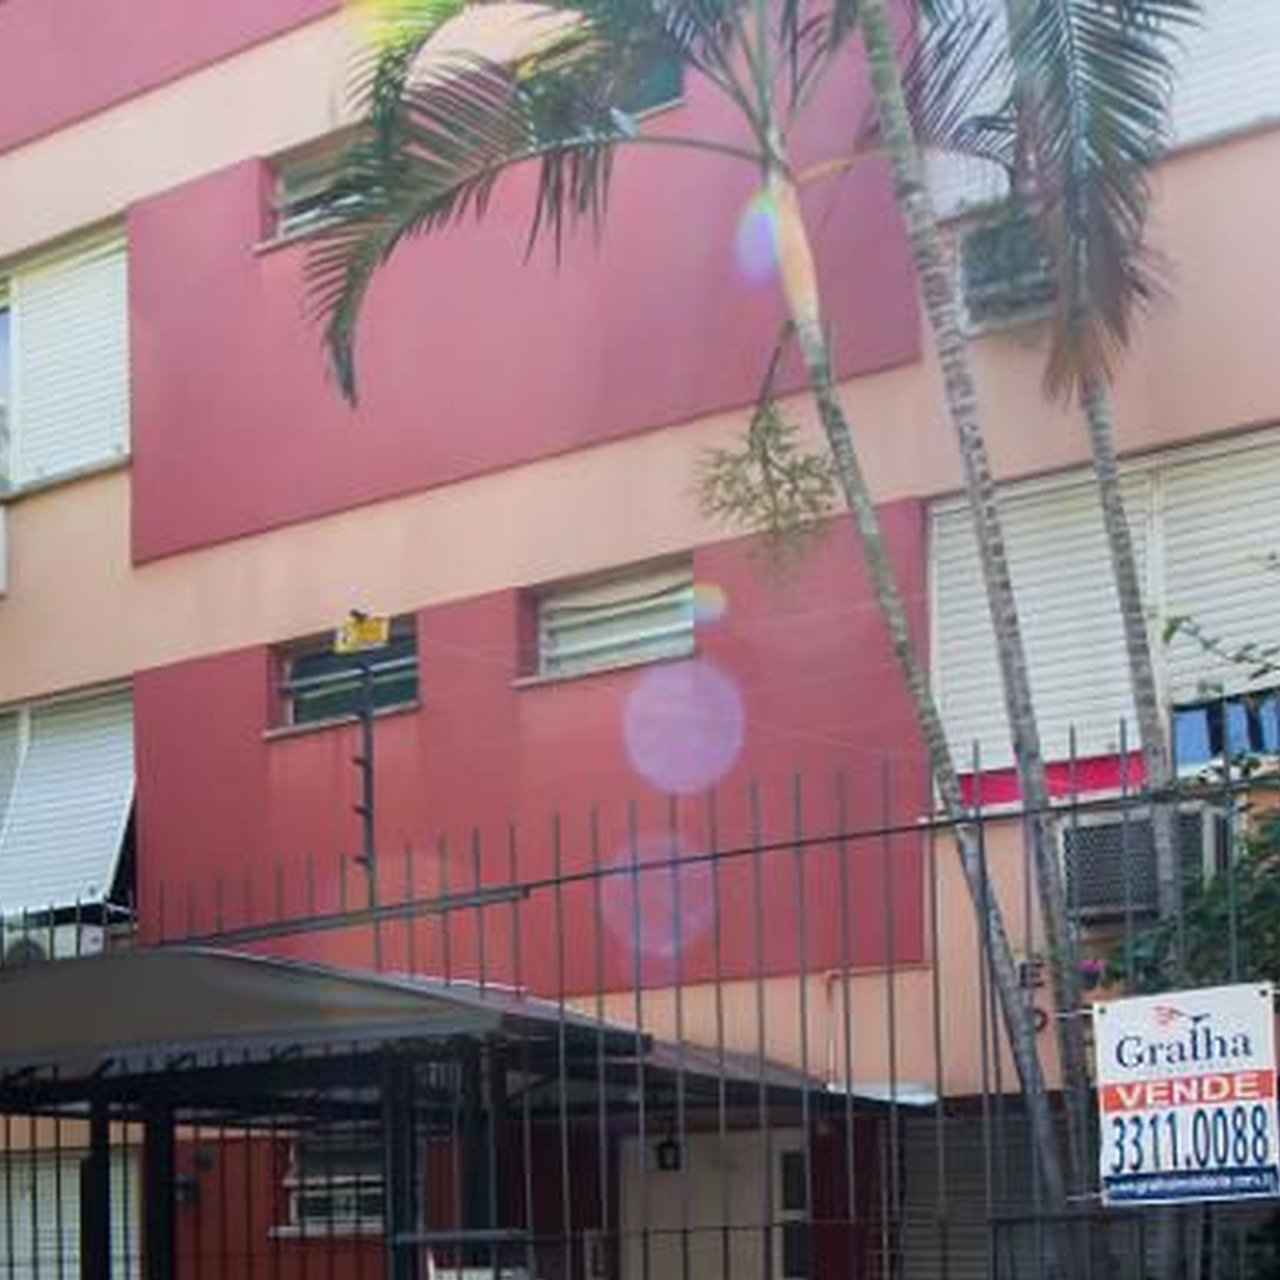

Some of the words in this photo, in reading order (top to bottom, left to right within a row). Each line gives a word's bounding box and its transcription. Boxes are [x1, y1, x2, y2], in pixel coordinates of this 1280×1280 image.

[1115, 1020, 1253, 1068] Gralha
[1115, 1073, 1261, 1107] VENDE
[1110, 1104, 1269, 1173] 3311.0088
